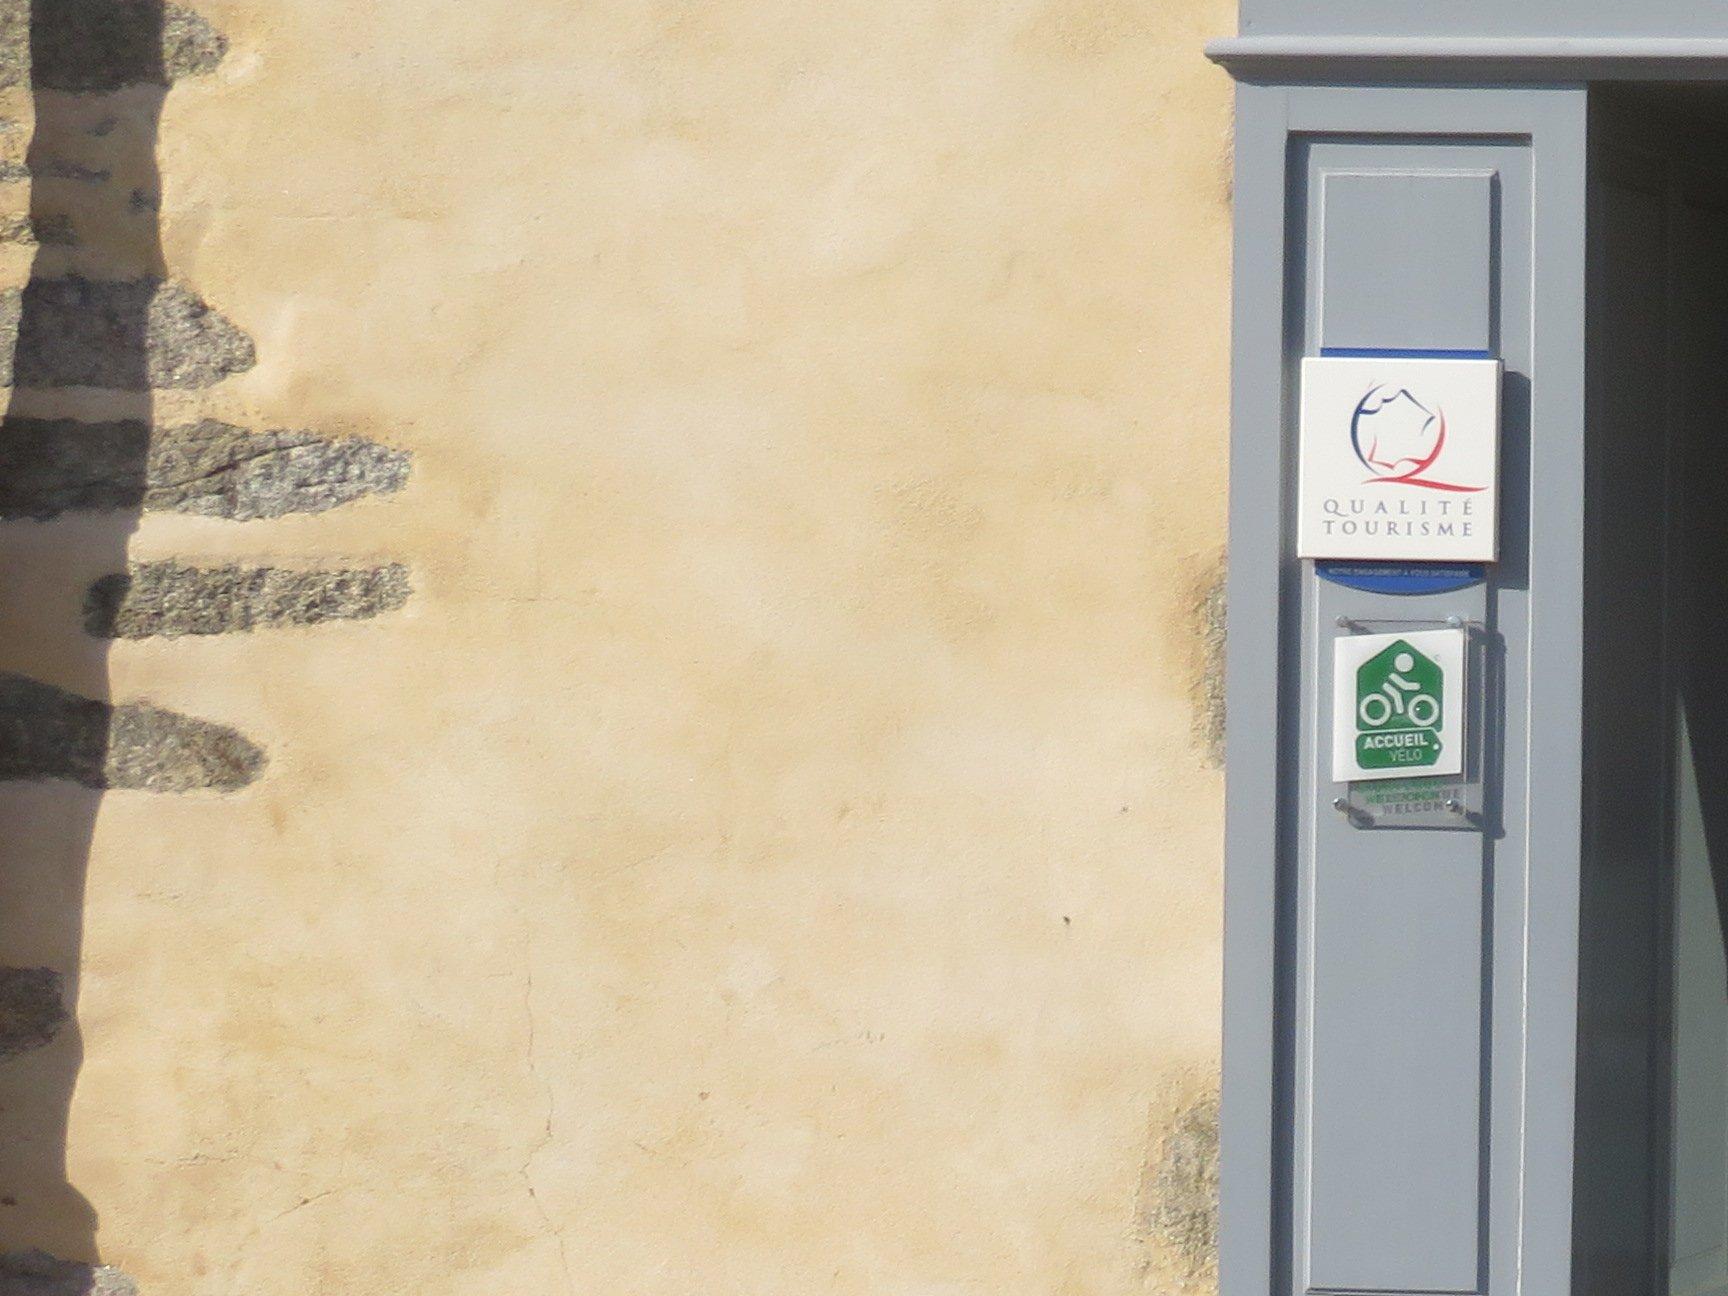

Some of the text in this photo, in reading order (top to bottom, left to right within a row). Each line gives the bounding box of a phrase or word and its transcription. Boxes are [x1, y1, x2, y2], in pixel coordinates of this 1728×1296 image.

[1323, 498, 1473, 519] QUALITÉ
[1322, 519, 1473, 537] TOURISME
[1363, 733, 1429, 750] ACCUEIL
